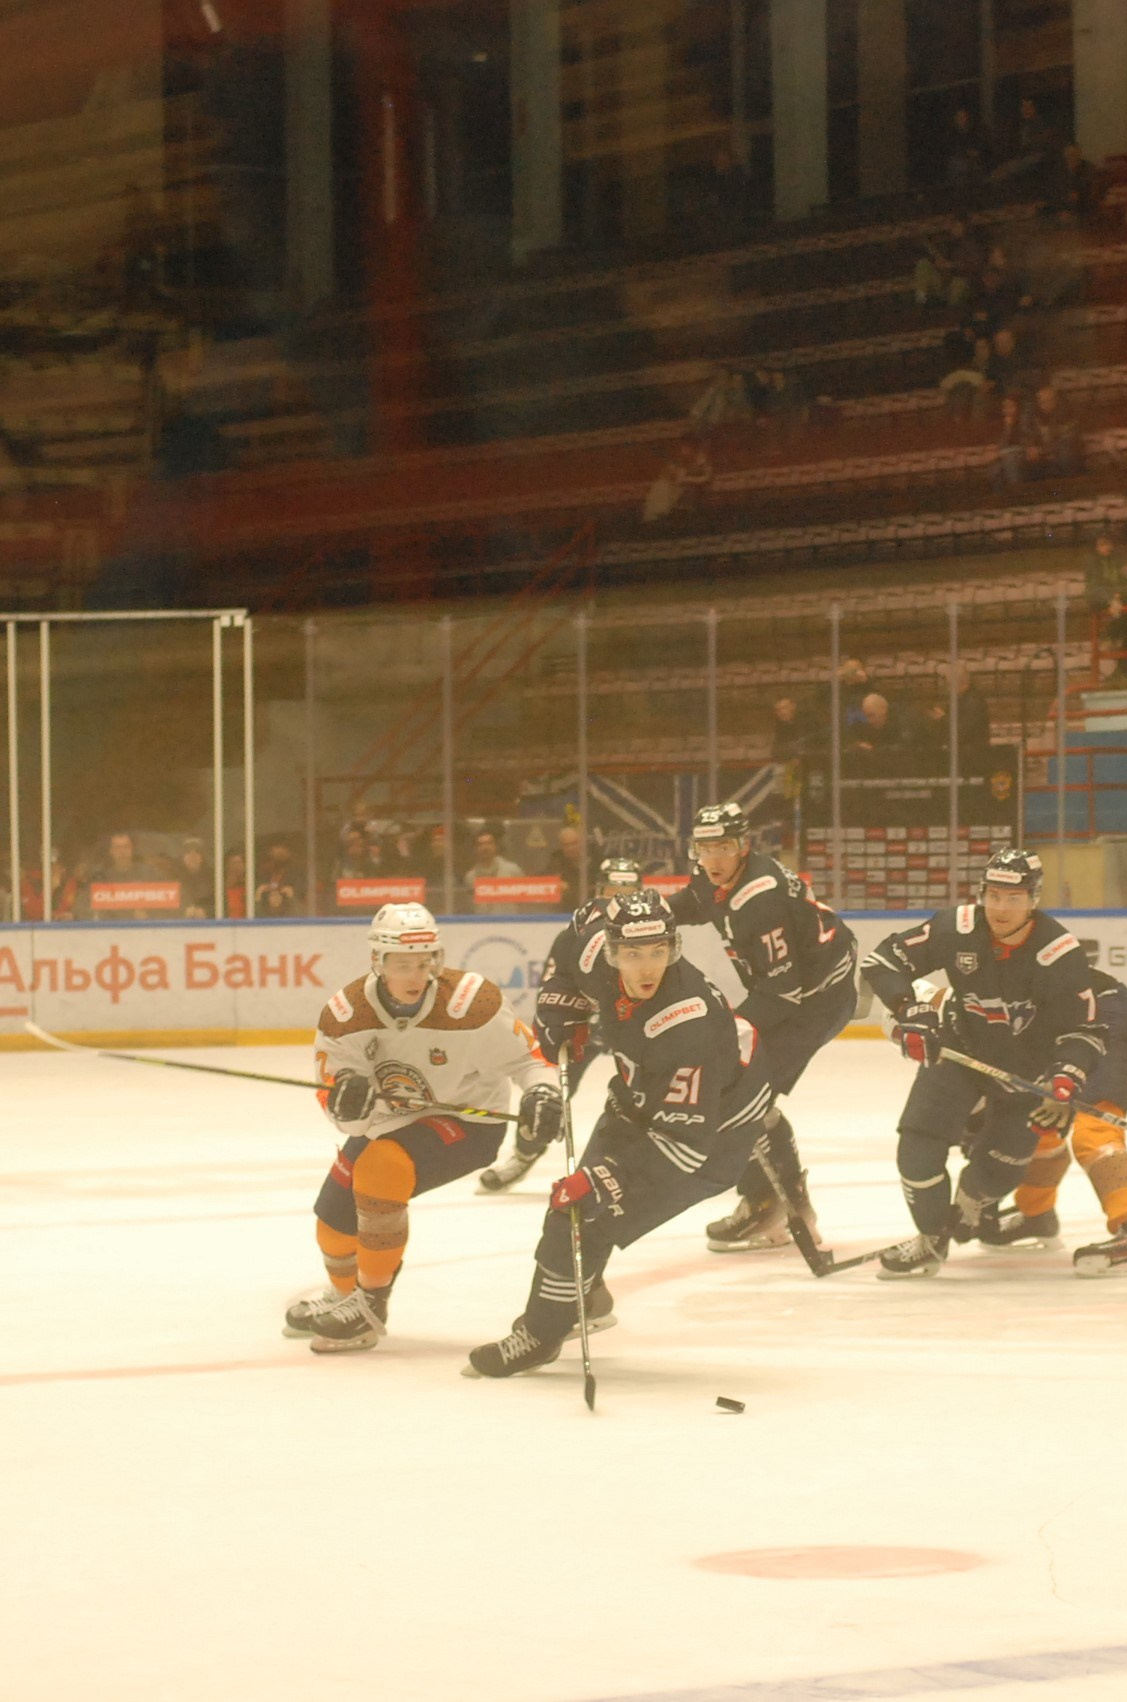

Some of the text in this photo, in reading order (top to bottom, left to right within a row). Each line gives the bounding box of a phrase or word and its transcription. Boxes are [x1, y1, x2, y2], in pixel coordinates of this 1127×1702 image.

[93, 888, 178, 903] OLIMPBET
[338, 885, 423, 899] OLIMPBET
[476, 883, 558, 897] OLIMPBET
[629, 902, 652, 917] 51
[760, 927, 789, 964] 75
[0, 943, 324, 1005] Альфа Банк
[537, 992, 590, 1011] BAUE
[649, 1002, 702, 1033] OLIMPBET
[663, 1065, 704, 1105] 51
[652, 1110, 706, 1126] NPP
[592, 1164, 625, 1218] BAUR
